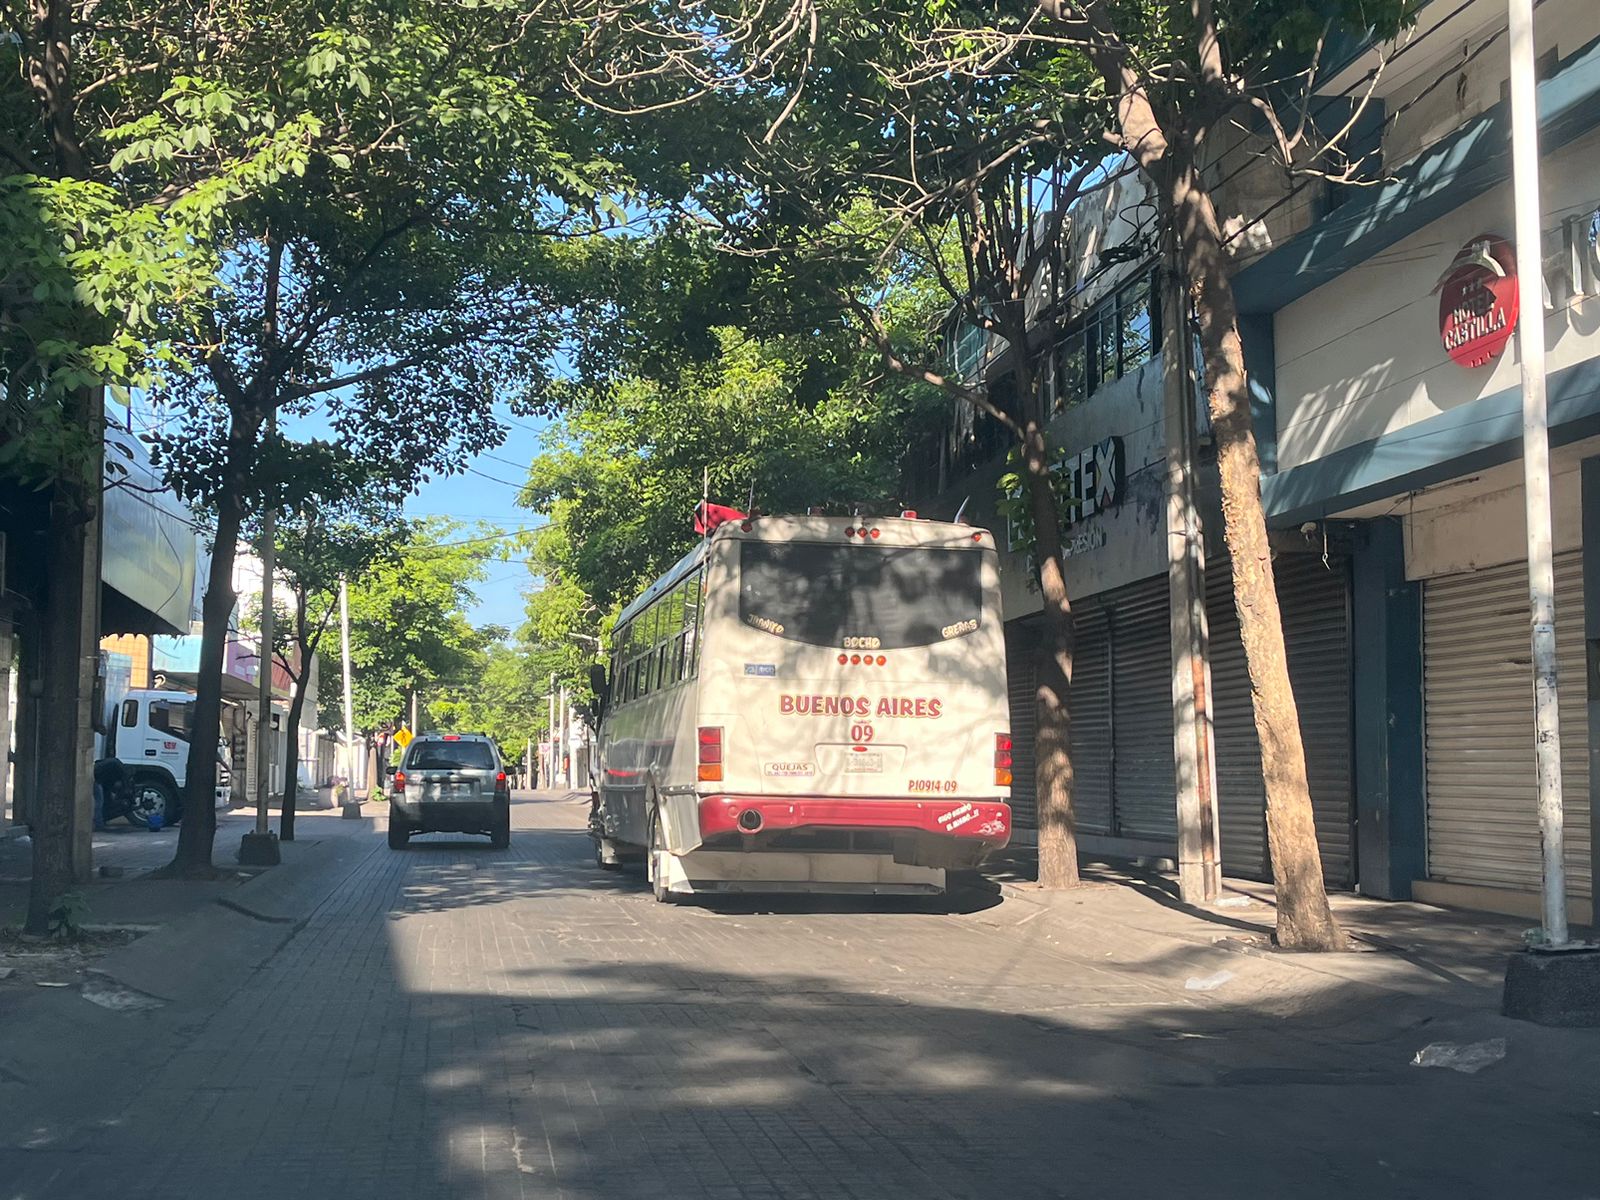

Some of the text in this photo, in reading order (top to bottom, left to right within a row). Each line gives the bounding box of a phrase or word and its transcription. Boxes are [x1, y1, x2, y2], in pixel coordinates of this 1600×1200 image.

[1445, 306, 1506, 350] CASTILLA
[844, 636, 881, 649] BOCHO
[779, 694, 943, 718] BUENOS AIRES
[851, 724, 874, 743] 09
[772, 763, 808, 771] QUEJAS
